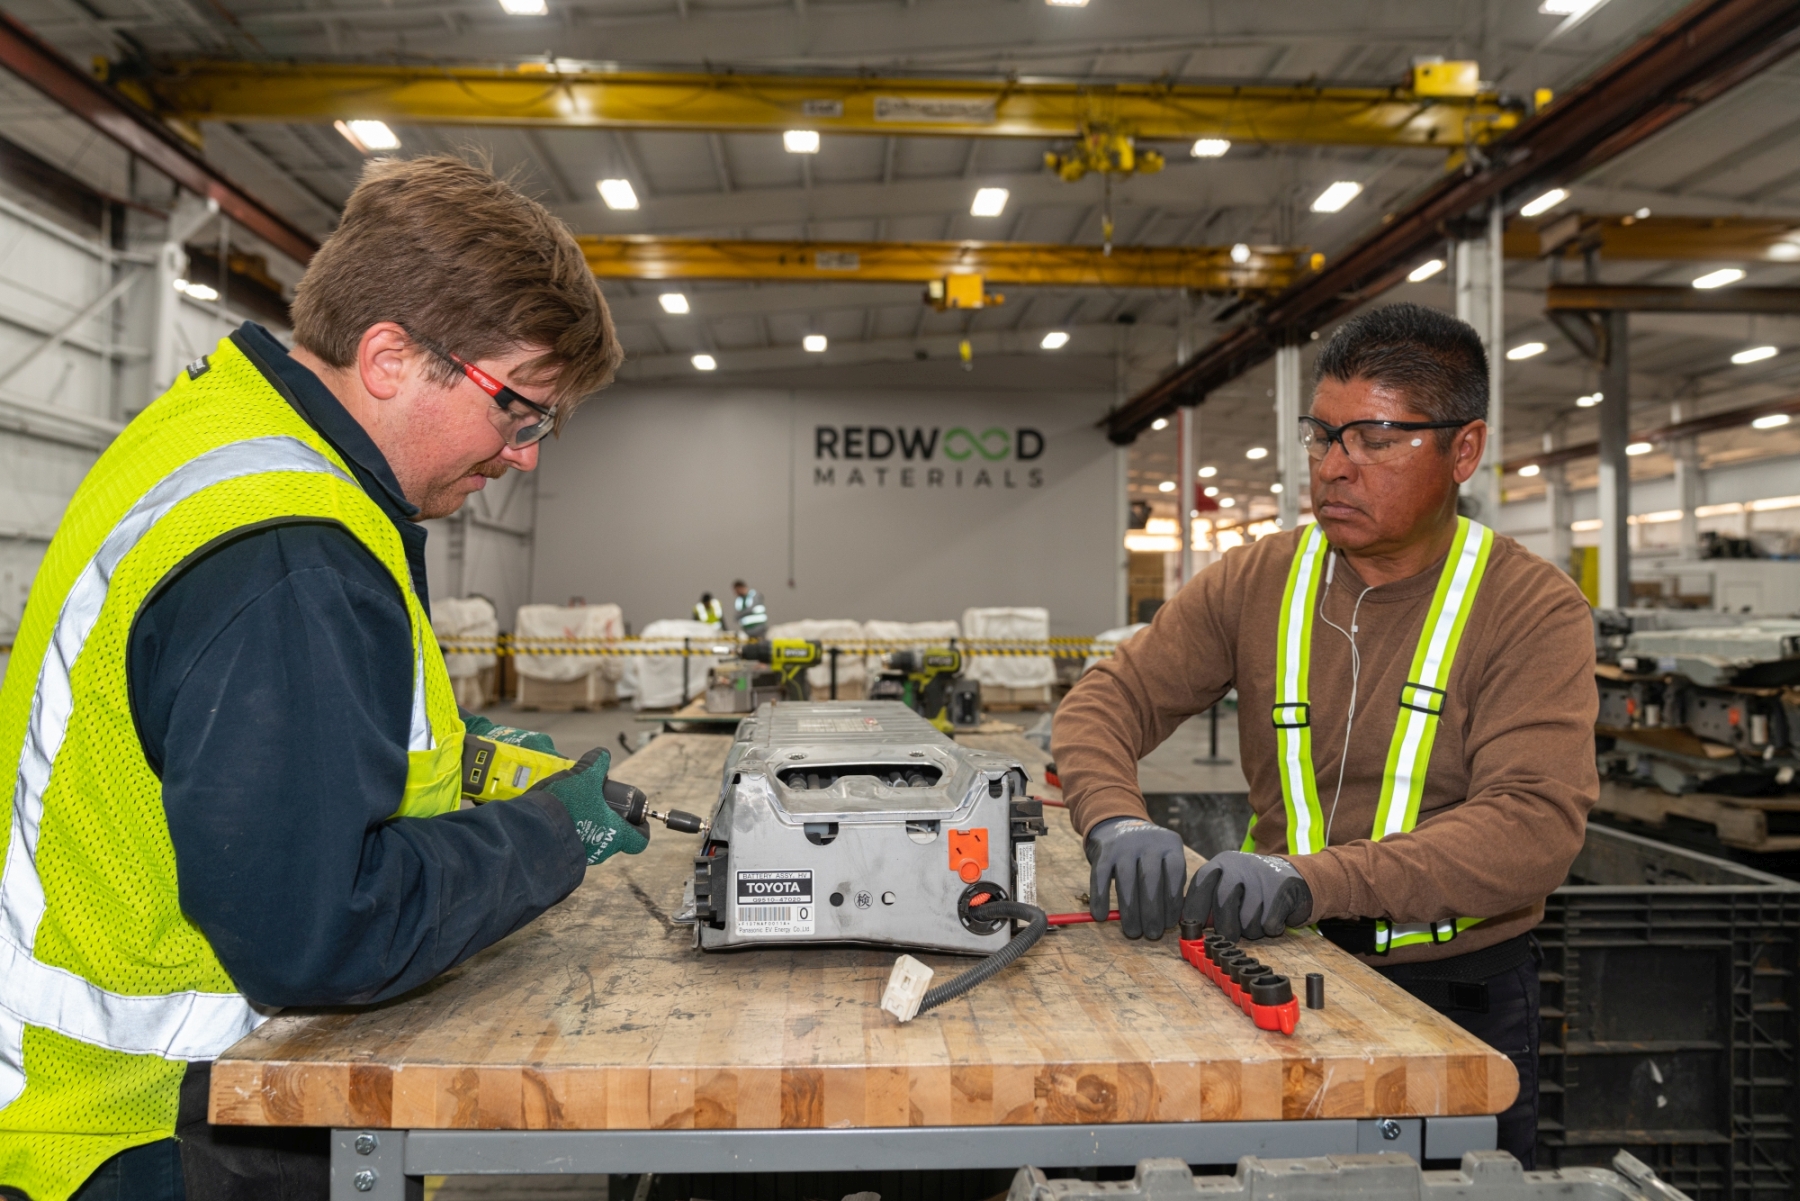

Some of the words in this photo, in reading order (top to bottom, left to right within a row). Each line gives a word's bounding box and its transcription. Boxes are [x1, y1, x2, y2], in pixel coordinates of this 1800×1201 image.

[815, 426, 1044, 461] REDWOOD
[813, 467, 1044, 488] MATERIALS
[746, 882, 800, 893] TOYOTA
[774, 926, 791, 934] Energy
